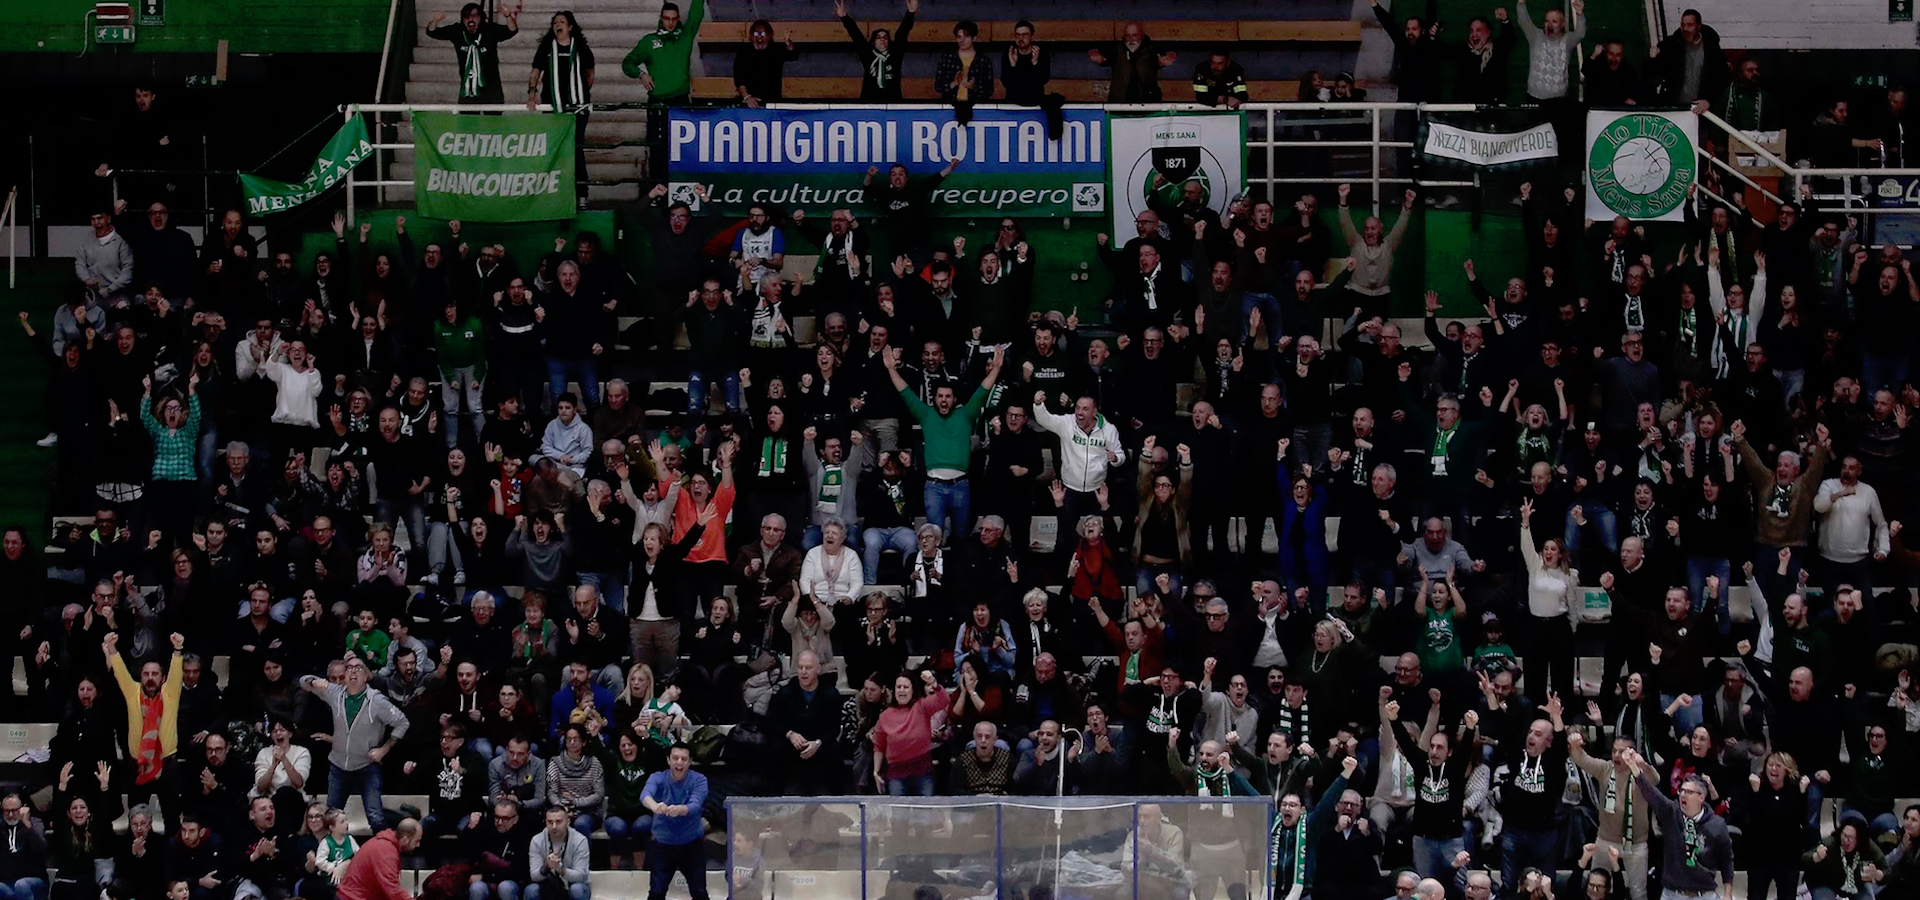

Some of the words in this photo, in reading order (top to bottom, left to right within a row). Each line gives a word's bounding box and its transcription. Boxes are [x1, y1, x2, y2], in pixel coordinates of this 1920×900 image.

[437, 131, 547, 159] GENTAGLIA
[669, 119, 898, 164] PIANIGIANI
[1155, 132, 1175, 140] MENS
[1176, 131, 1197, 139] SANA
[1470, 130, 1554, 158] BIANCOVERDE
[1600, 124, 1630, 149] Io
[1632, 115, 1678, 149] Tifo
[323, 139, 374, 190] SANA
[1164, 157, 1187, 169] 1871
[426, 167, 562, 197] BIANCOVERDE
[708, 183, 744, 204] La
[751, 182, 865, 204] cultura
[929, 187, 1069, 209] recupero
[1590, 161, 1642, 215] Mens
[1645, 167, 1692, 214] Sana
